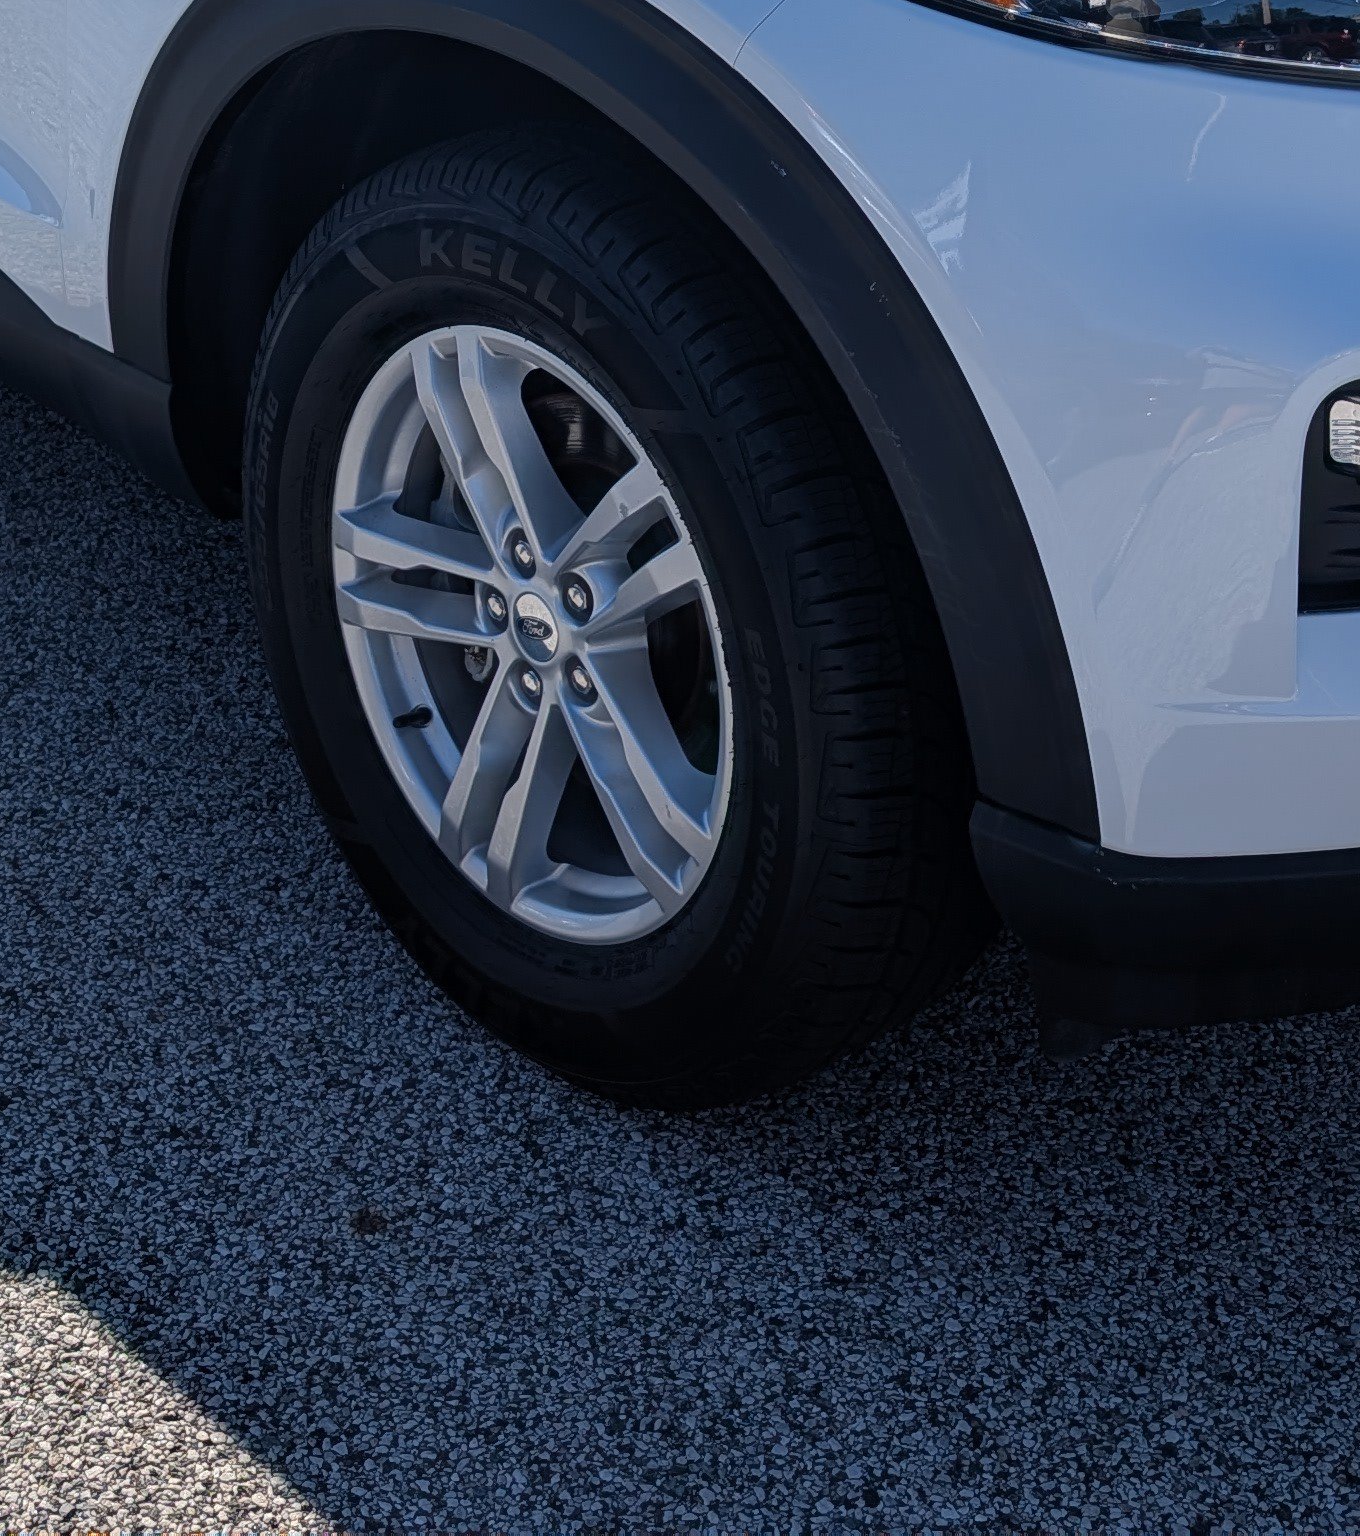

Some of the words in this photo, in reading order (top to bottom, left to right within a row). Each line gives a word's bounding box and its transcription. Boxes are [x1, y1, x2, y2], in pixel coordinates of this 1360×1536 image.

[418, 227, 610, 337] KELLY
[522, 618, 545, 637] Ford
[743, 627, 781, 768] EDGE
